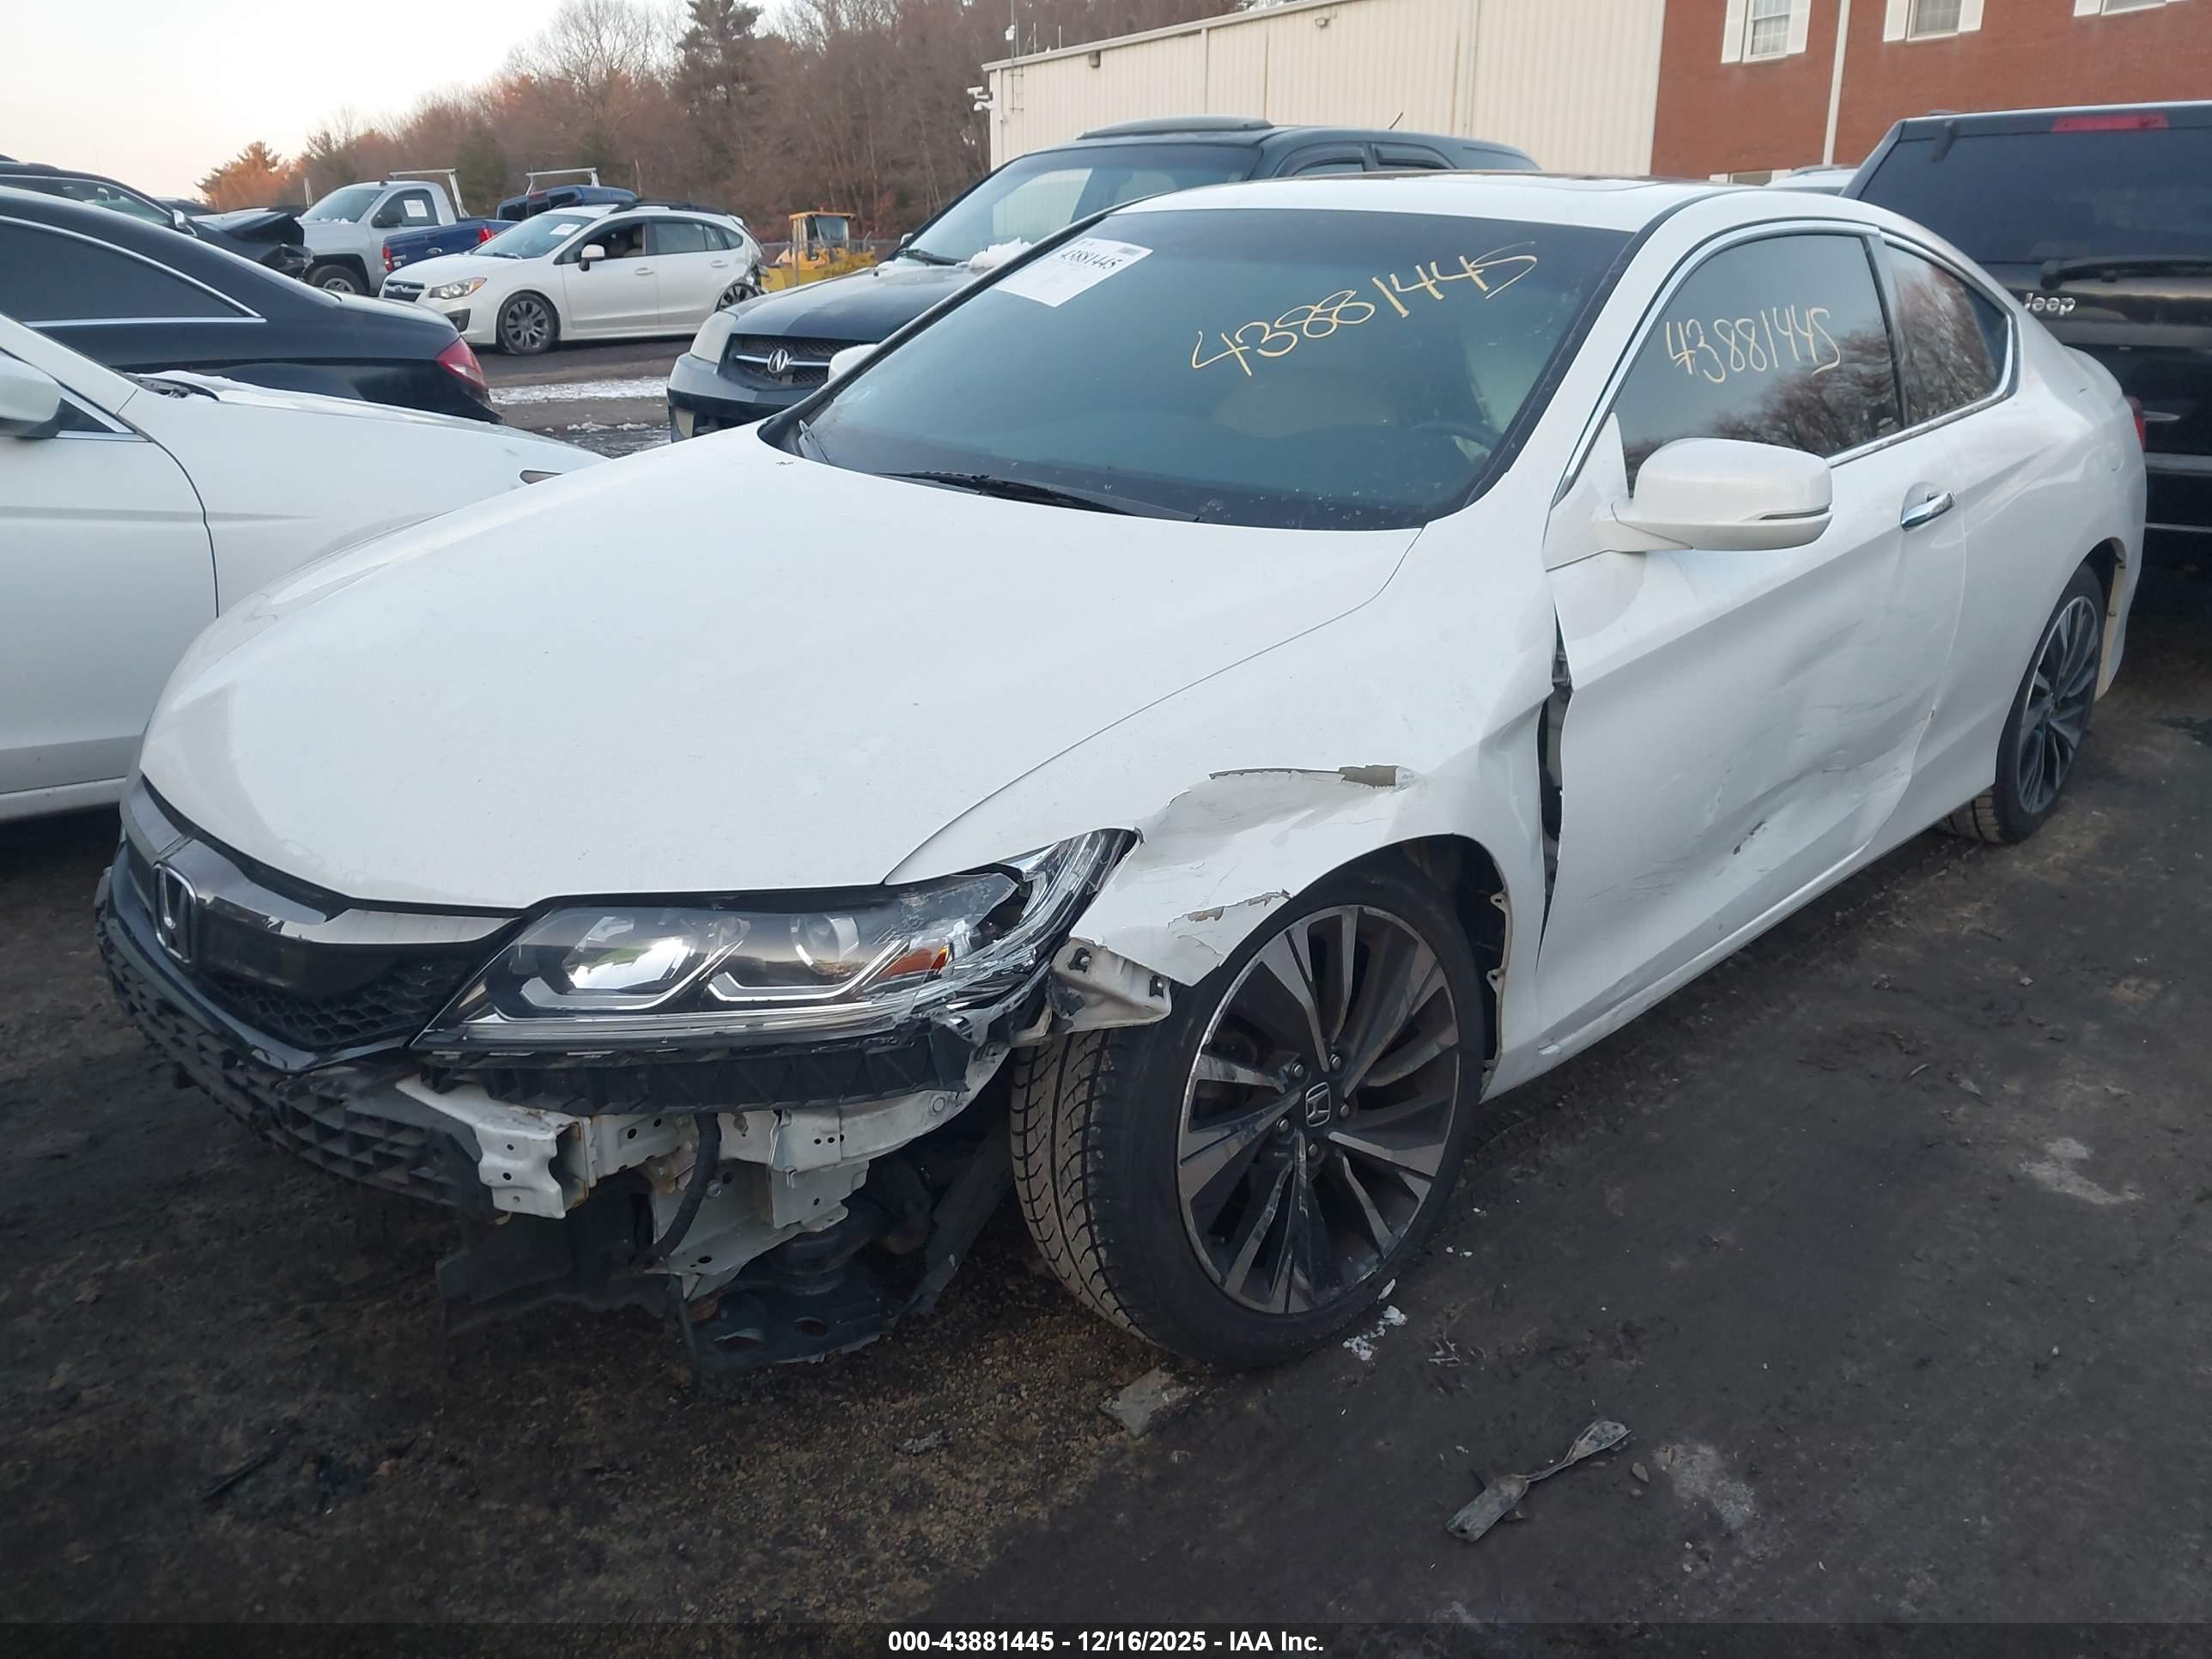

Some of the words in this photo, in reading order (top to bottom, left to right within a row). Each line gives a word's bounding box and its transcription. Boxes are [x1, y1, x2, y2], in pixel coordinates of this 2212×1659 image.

[1191, 241, 1537, 377] 43881445
[2024, 292, 2076, 315] Jeep
[1666, 304, 1840, 383] 43881445
